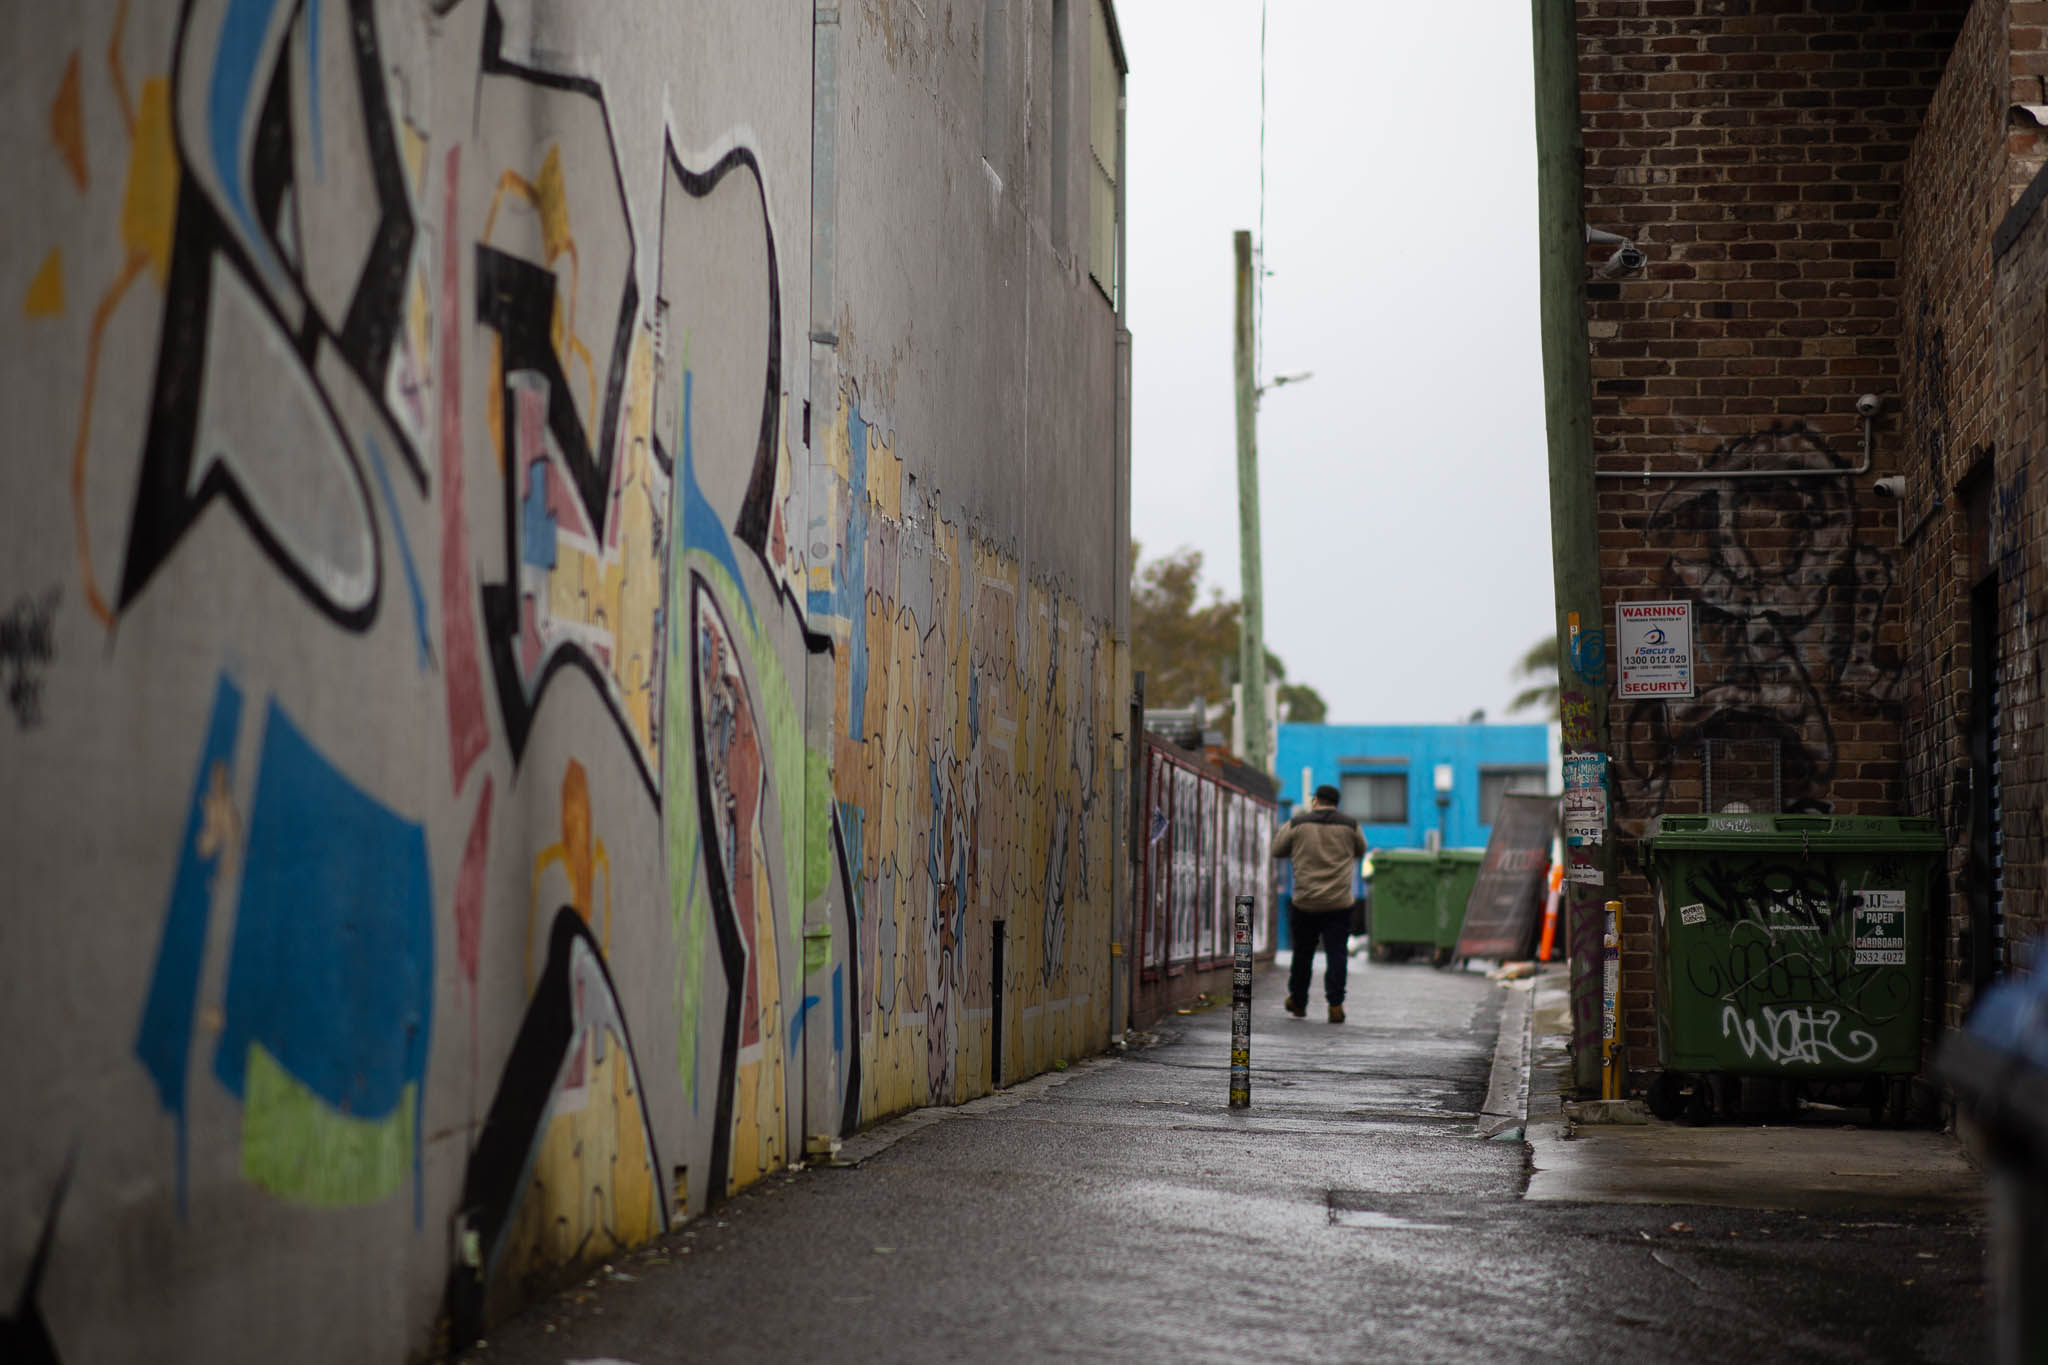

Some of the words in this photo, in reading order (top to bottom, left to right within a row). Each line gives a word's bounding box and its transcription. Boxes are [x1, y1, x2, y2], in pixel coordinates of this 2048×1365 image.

[1622, 606, 1686, 617] WARNING
[1634, 647, 1676, 655] iSecure
[1625, 656, 1647, 665] 1300
[1650, 656, 1667, 664] 012
[1670, 655, 1687, 663] 029
[1624, 681, 1688, 692] SECURITY
[1866, 912, 1894, 924] PAPER
[1874, 925, 1884, 936] &
[1856, 937, 1903, 949] CARDBOARD
[1856, 952, 1878, 962] 9832
[1881, 951, 1903, 962] 4022
